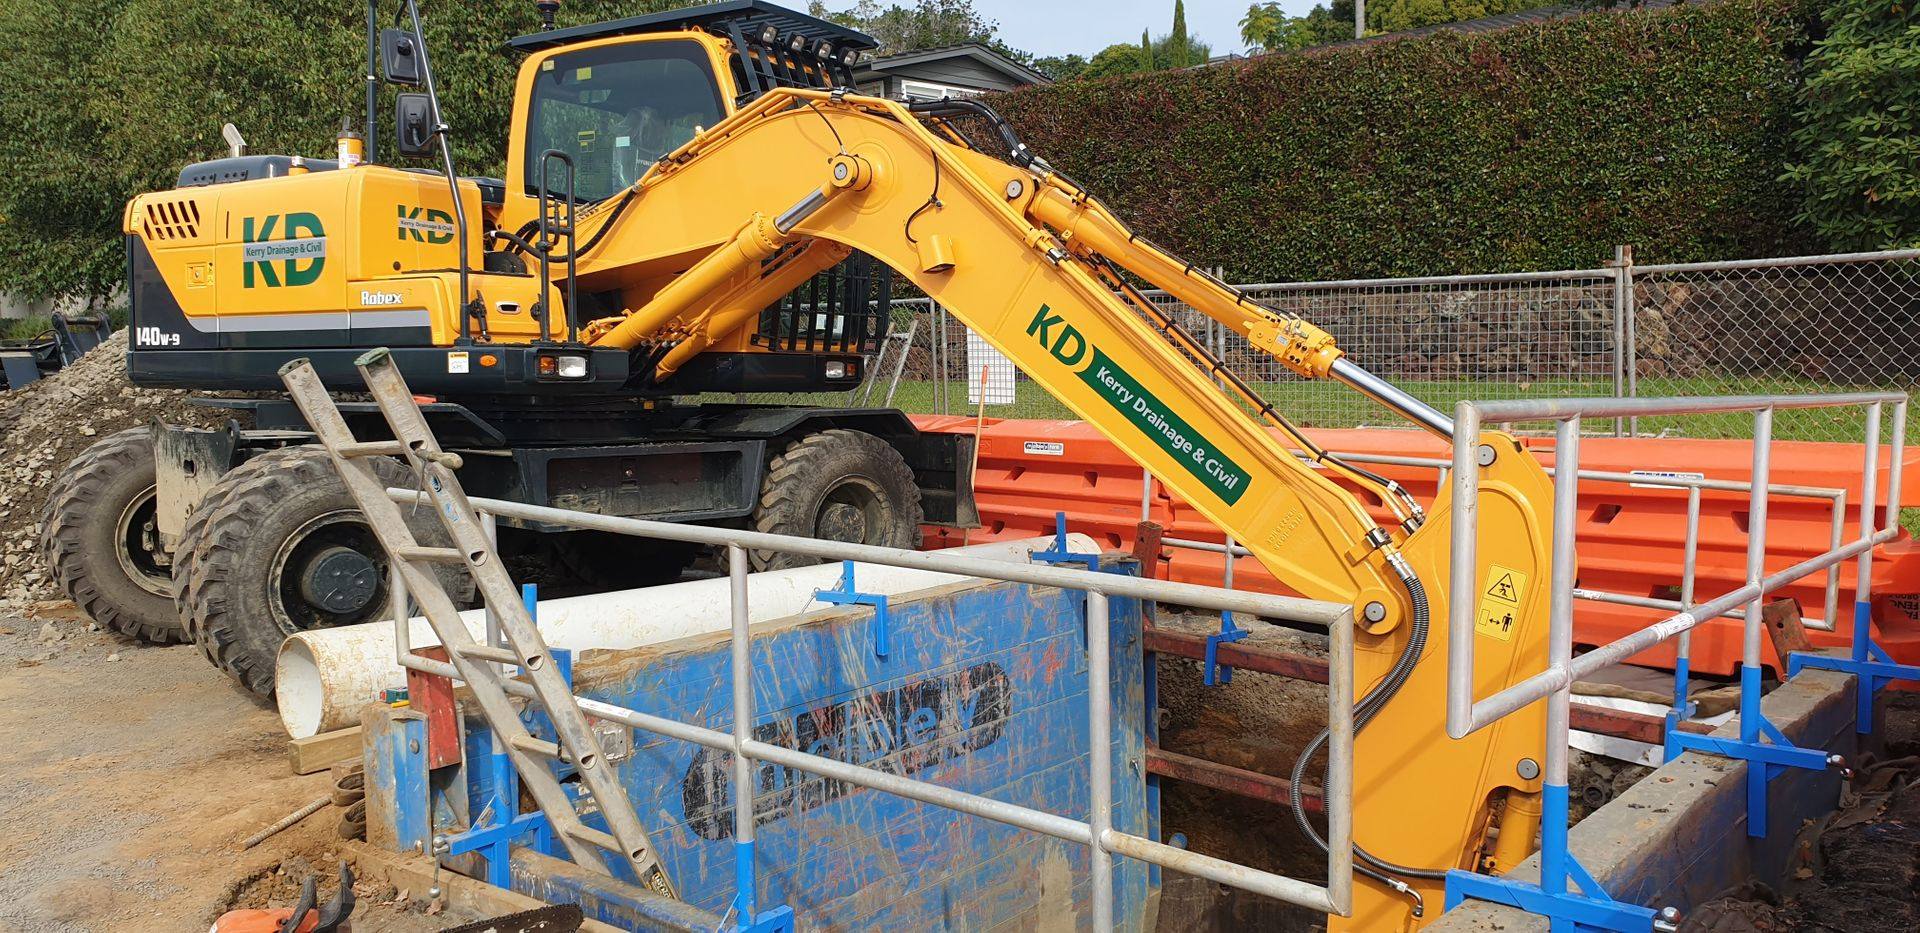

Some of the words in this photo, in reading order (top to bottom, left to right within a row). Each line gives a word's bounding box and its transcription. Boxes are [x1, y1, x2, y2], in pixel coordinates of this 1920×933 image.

[246, 247, 266, 258] Kerry
[267, 245, 298, 256] Drainage
[299, 243, 305, 253] &
[306, 241, 322, 252] Civil
[398, 204, 455, 244] KD
[243, 212, 326, 289] KD
[361, 290, 403, 305] Robex
[1026, 303, 1087, 366] KD
[1096, 366, 1134, 404] Kerry
[1133, 397, 1193, 453] Drainage
[1192, 448, 1205, 464] &
[1204, 458, 1239, 490] Civil
